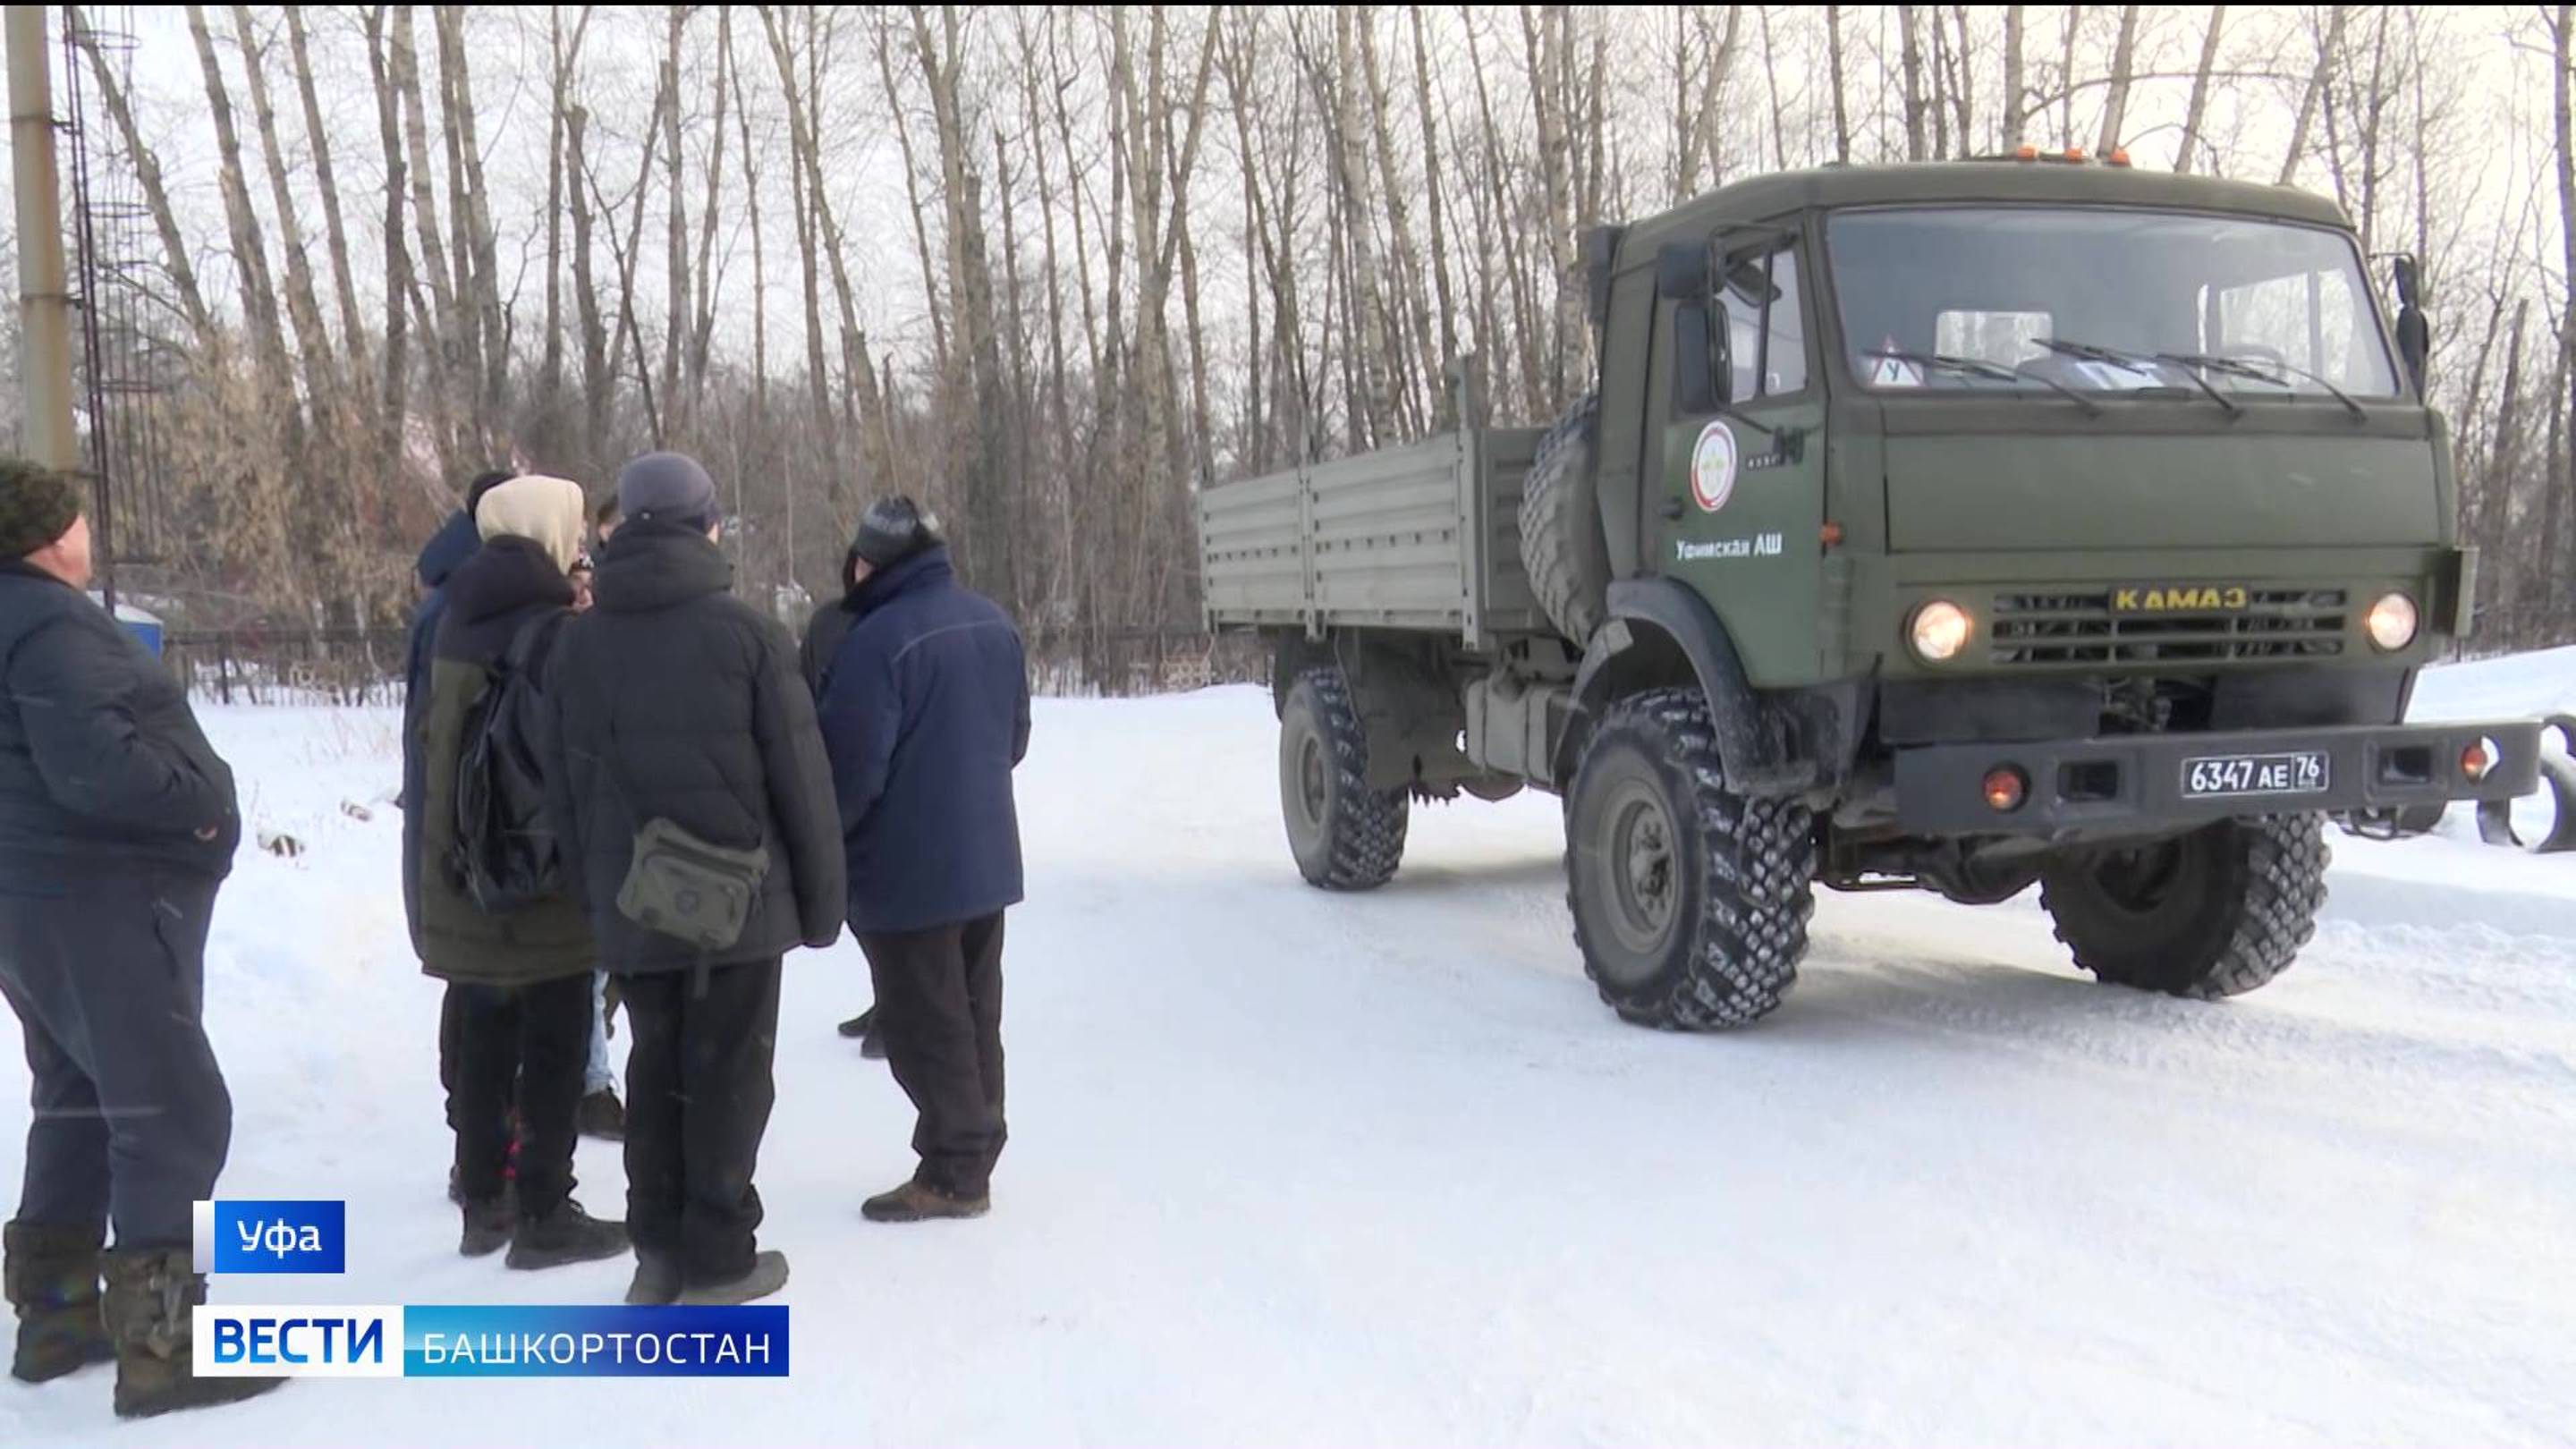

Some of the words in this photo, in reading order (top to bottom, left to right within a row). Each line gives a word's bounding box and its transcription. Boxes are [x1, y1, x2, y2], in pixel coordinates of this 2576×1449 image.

[1754, 532, 1783, 556] АШ
[2115, 587, 2247, 611] КАМАЗ
[2190, 760, 2254, 792] 6347
[2258, 765, 2289, 788] АЕ
[2296, 756, 2320, 778] 76
